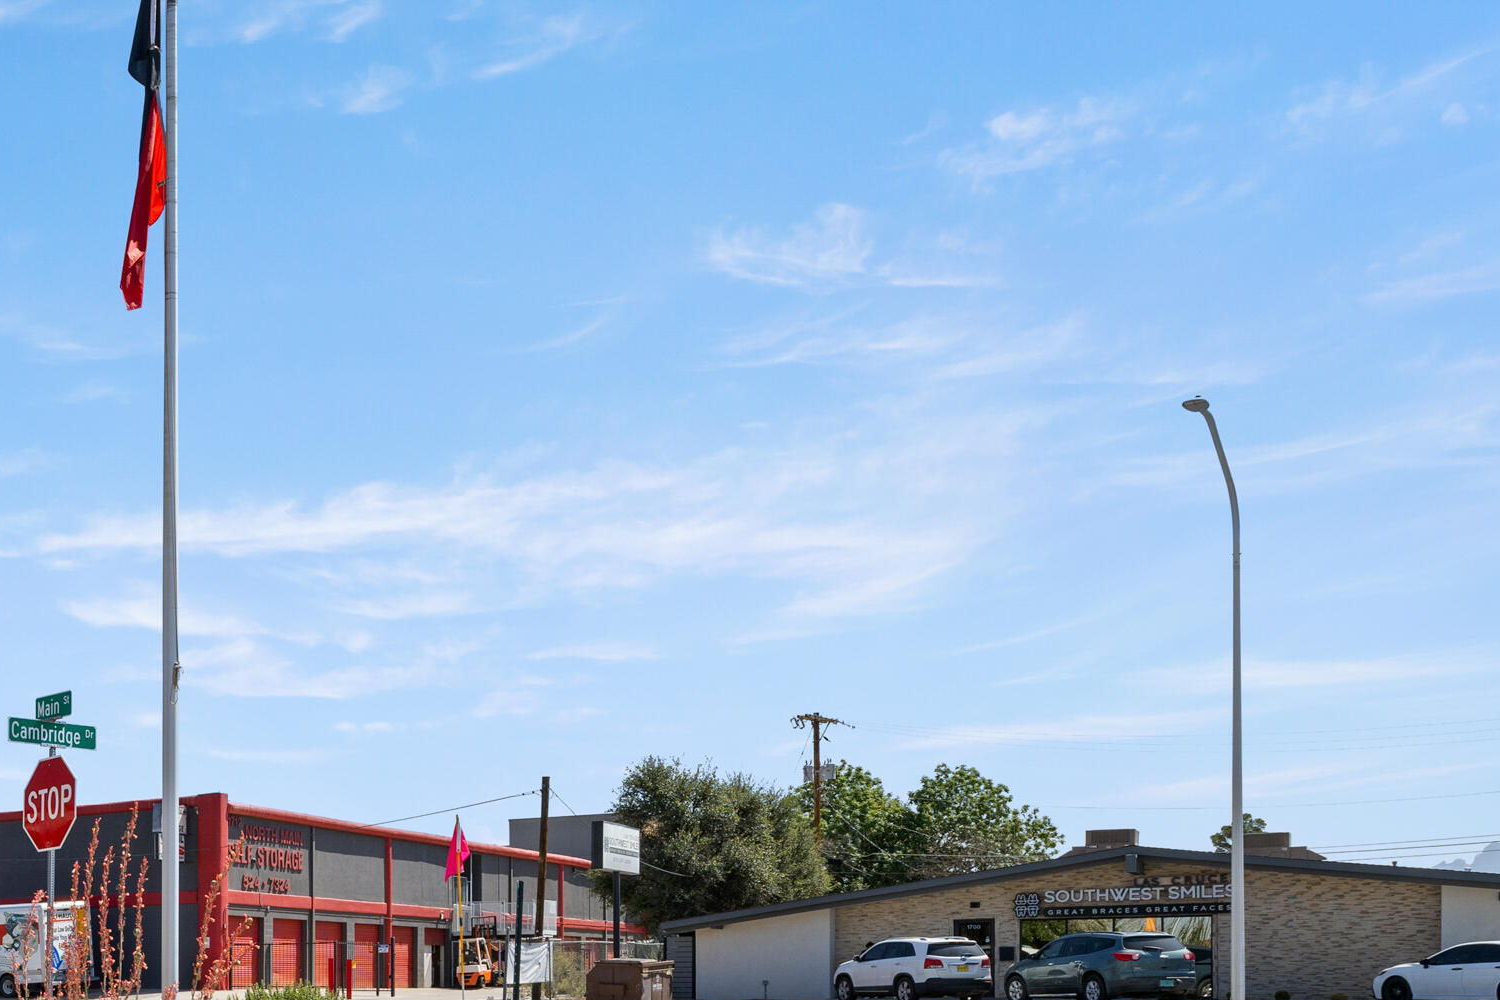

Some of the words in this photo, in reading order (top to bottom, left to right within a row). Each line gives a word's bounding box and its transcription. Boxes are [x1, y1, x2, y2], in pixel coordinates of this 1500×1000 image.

[37, 699, 60, 718] Main
[63, 695, 70, 704] St
[11, 721, 81, 748] Cambridge
[85, 729, 94, 739] Dr
[26, 784, 72, 824] STOP
[245, 824, 278, 843] NORTH
[280, 829, 304, 847] MAIN
[257, 846, 305, 871] STORAGE
[1134, 877, 1160, 887] LAS
[1170, 873, 1229, 886] CRUCE
[1043, 887, 1164, 904] SOUTHWEST
[1167, 884, 1232, 900] SMILES
[1047, 908, 1085, 916] GREAT
[1091, 906, 1139, 915] BRACES
[1146, 905, 1186, 913] GREAT
[1192, 904, 1232, 912] FACES
